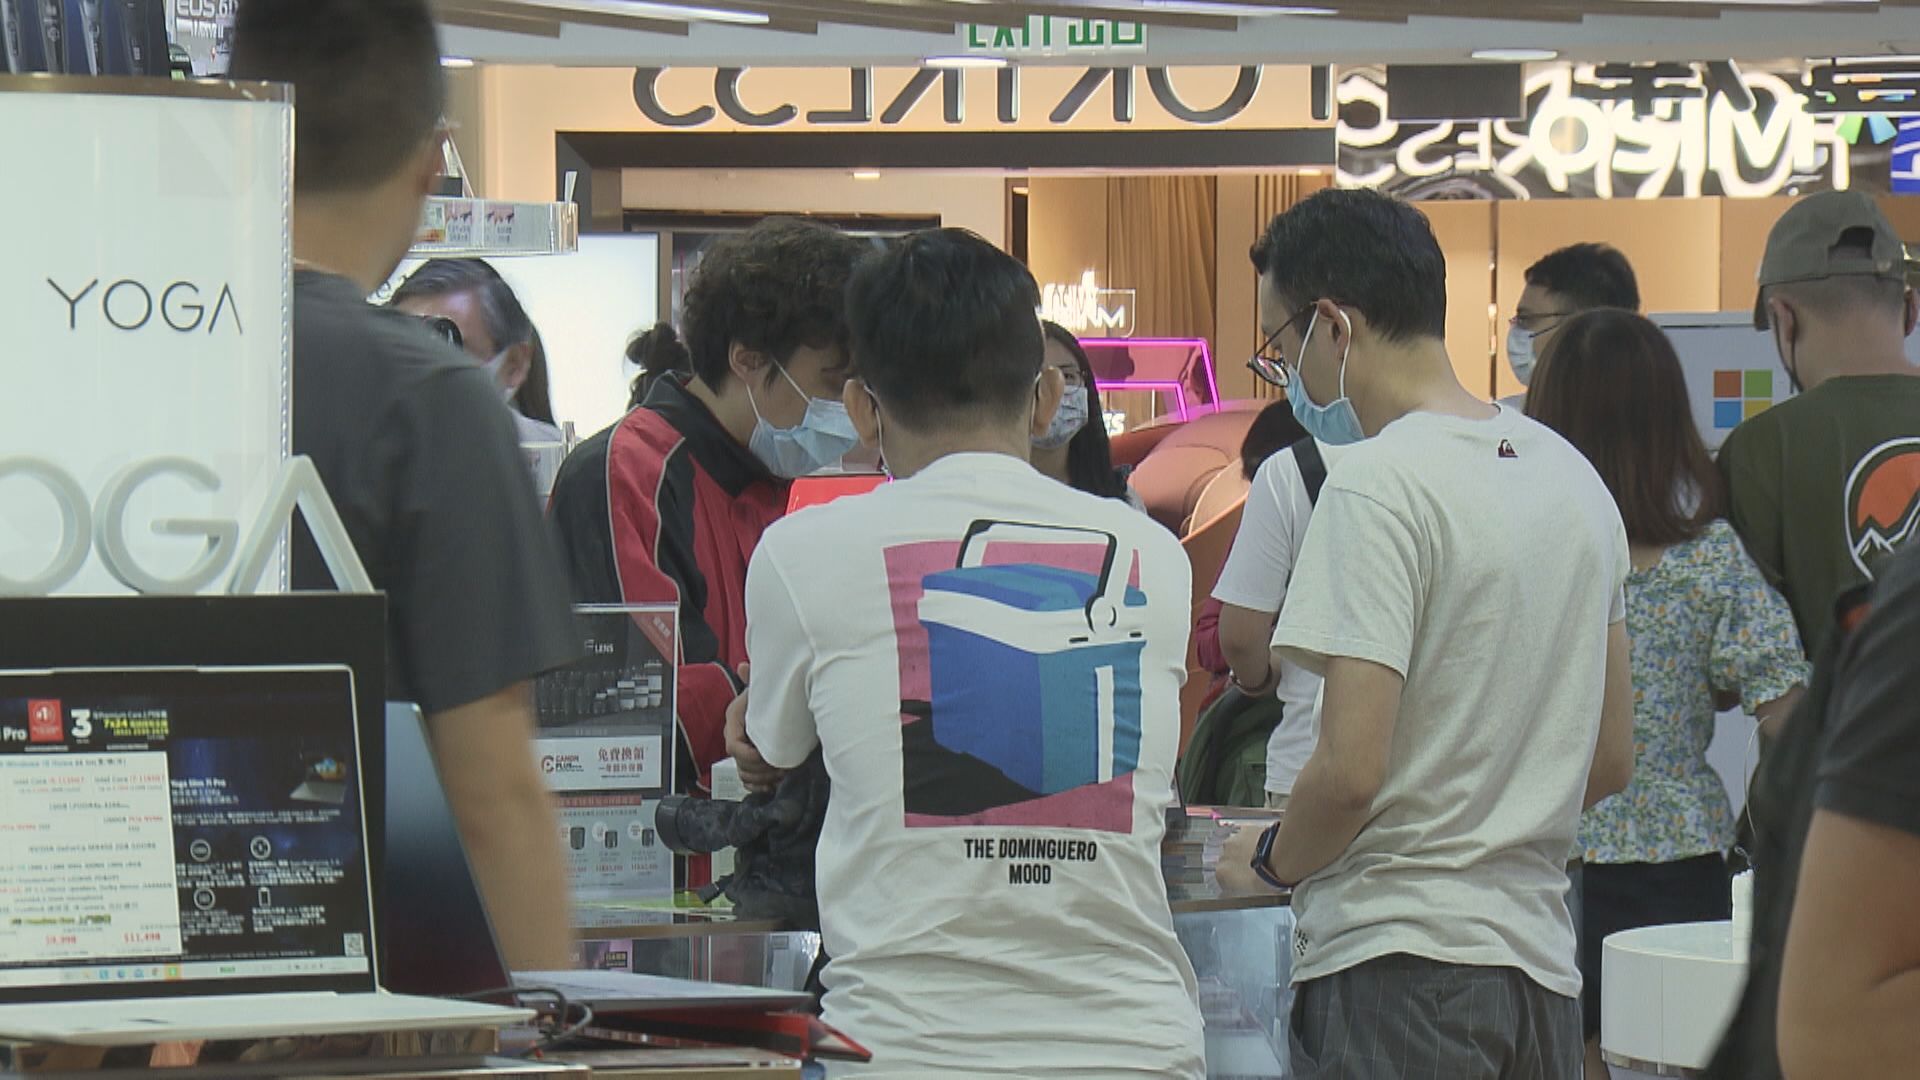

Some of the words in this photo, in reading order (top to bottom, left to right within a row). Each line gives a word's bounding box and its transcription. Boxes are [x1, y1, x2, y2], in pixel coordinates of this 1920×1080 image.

[47, 277, 243, 335] YOGA
[2, 726, 27, 741] Pro
[70, 708, 92, 738] 3
[964, 839, 994, 858] THE
[999, 839, 1097, 861] DOMINGUERO
[1009, 864, 1052, 884] MOOD
